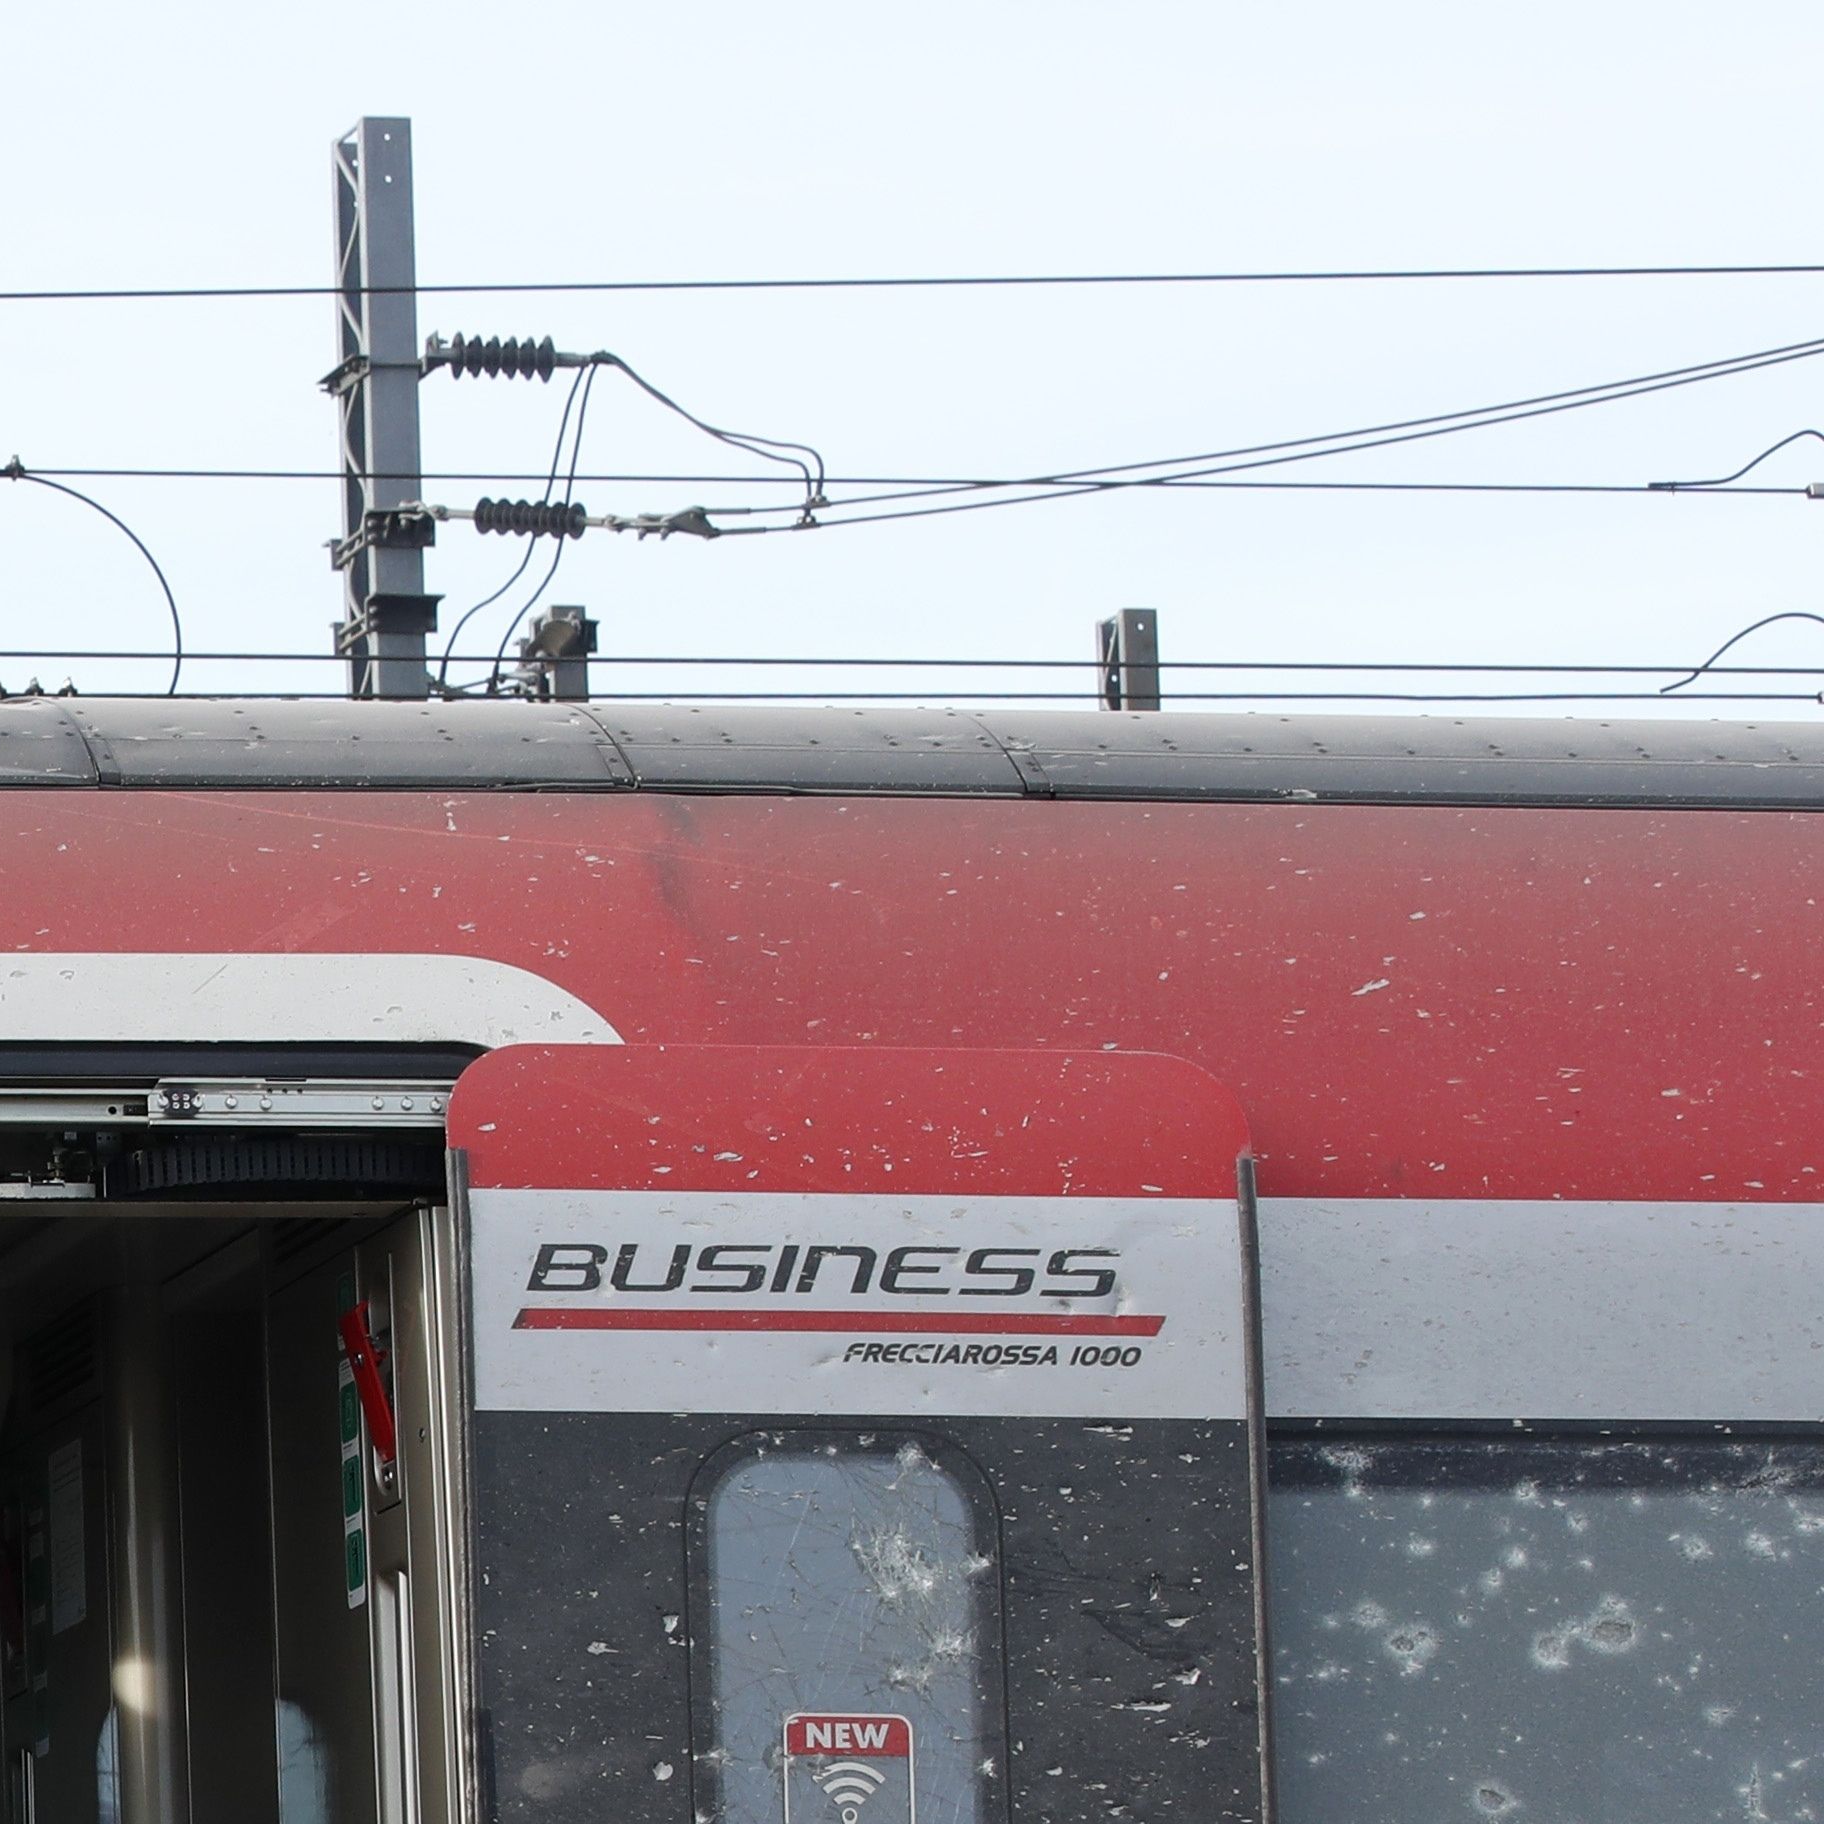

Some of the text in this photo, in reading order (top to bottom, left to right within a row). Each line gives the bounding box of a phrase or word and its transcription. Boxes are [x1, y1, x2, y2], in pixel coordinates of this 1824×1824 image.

[526, 1243, 1121, 1298] BUSINESS
[842, 1342, 1142, 1367] FRECCIAROSSA 1000
[806, 1723, 890, 1749] NEW
